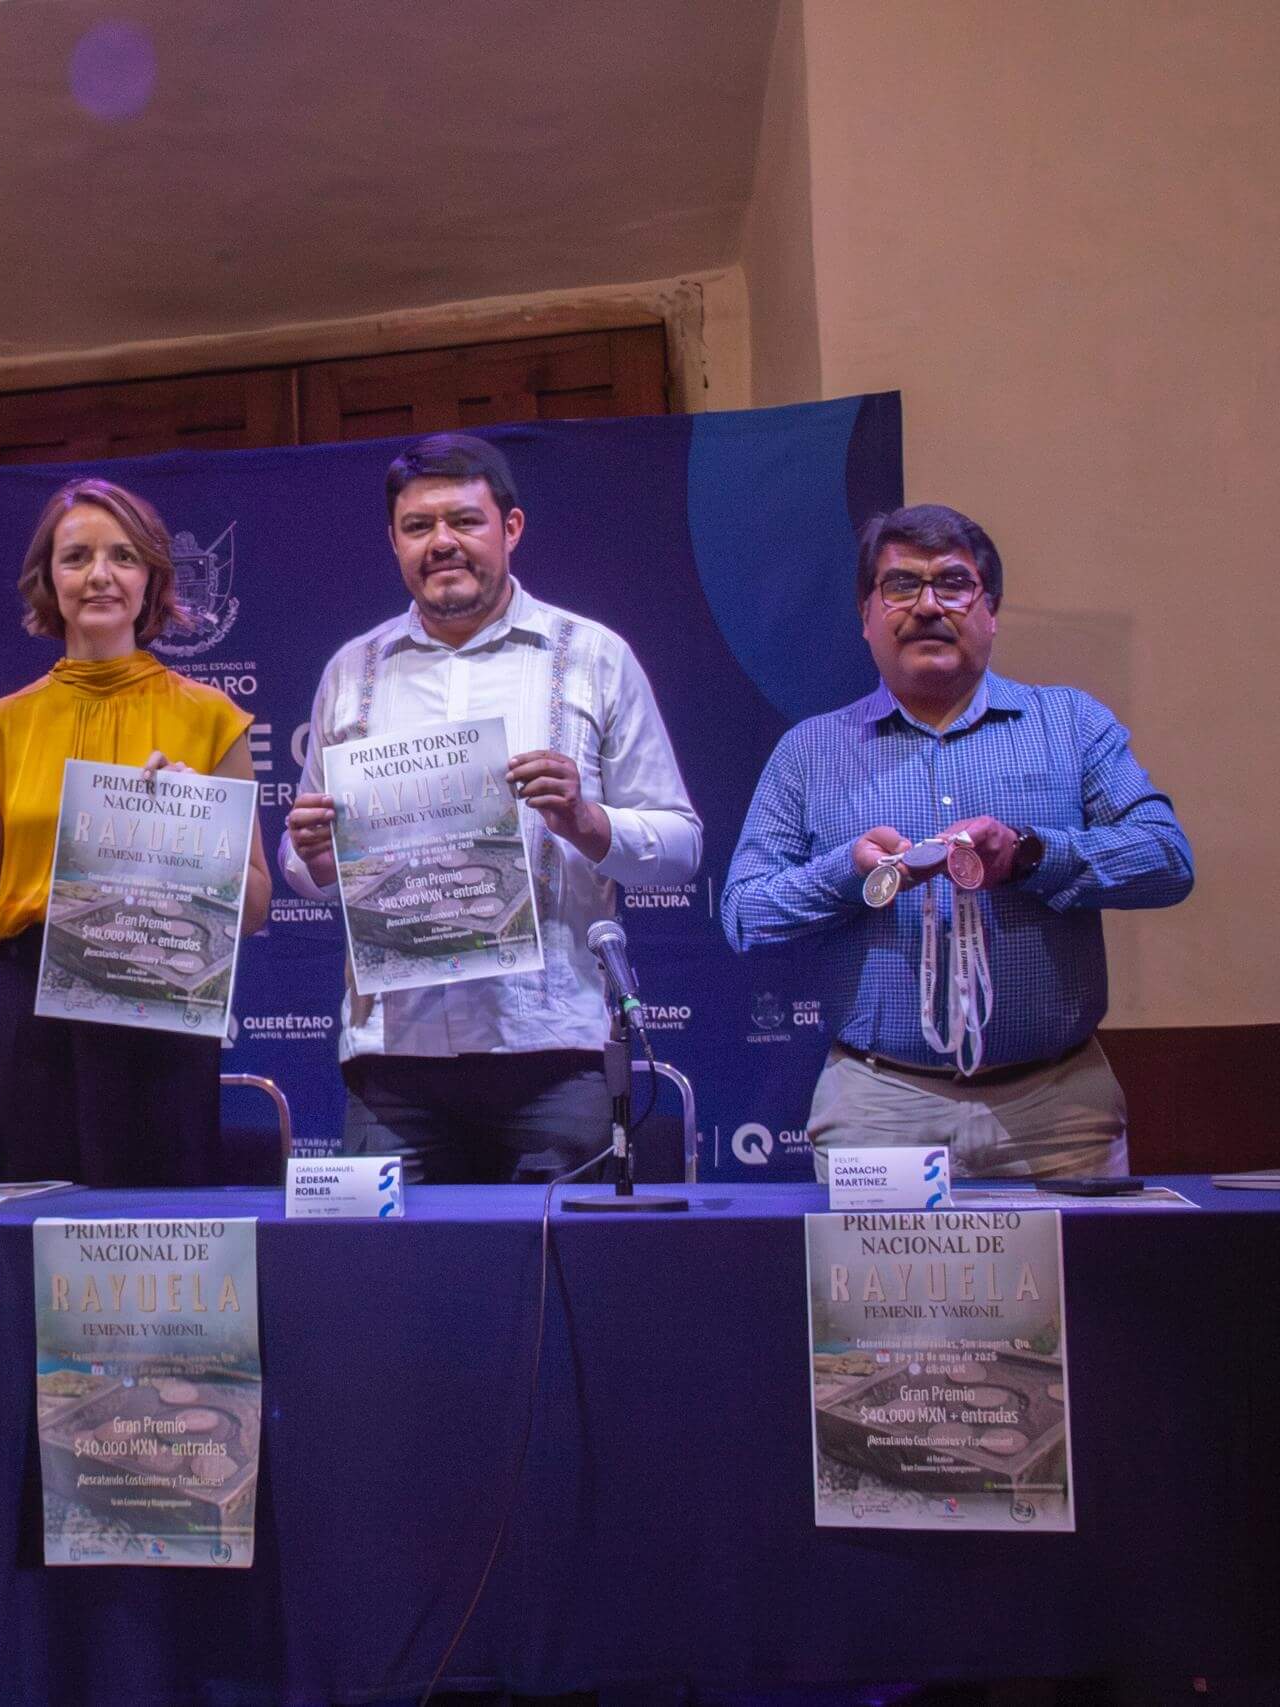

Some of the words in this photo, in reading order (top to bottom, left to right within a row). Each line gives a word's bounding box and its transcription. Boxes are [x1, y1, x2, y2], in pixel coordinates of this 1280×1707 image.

[349, 741, 408, 766] PRIMER
[412, 729, 480, 751] TORNEO
[363, 758, 444, 781] NACIONAL
[447, 749, 470, 766] DE
[92, 774, 156, 795] PRIMER
[160, 782, 227, 803] TORNEO
[342, 764, 501, 821] RAYUELA
[103, 794, 186, 817] NACIONAL
[190, 805, 212, 821] DE
[370, 813, 418, 830] FEMENIL
[419, 811, 427, 822] Y
[428, 804, 476, 820] VARONIL
[73, 811, 233, 861] RAYUELA
[97, 847, 145, 863] FEMENIL
[147, 853, 155, 864] Y
[156, 854, 204, 870] VARONIL
[405, 874, 428, 889] Gran
[429, 870, 463, 886] Premio
[421, 890, 443, 904] MXN
[452, 881, 497, 899] entradas
[624, 894, 690, 908] CULTURA
[115, 912, 138, 926] Gran
[139, 916, 172, 930] Premio
[271, 908, 333, 922] CULTURA
[125, 931, 149, 945] MXN
[158, 934, 201, 951] entradas
[243, 1013, 333, 1030] QUERÉTARO
[250, 1031, 283, 1040] JUNTOS
[325, 1165, 354, 1173] MANUEL
[834, 1165, 887, 1175] CAMACHO
[295, 1175, 340, 1184] LEDESMA
[834, 1177, 888, 1187] MARTÍNEZ
[295, 1186, 331, 1196] ROBLES
[64, 1222, 139, 1239] PRIMER
[143, 1221, 225, 1239] TORNEO
[843, 1213, 926, 1231] PRIMER
[934, 1212, 1021, 1230] TORNEO
[80, 1244, 178, 1262] NACIONAL
[183, 1244, 209, 1261] DE
[861, 1236, 971, 1254] NACIONAL
[976, 1236, 1005, 1253] DE
[830, 1262, 1040, 1303] RAYUELA
[51, 1272, 241, 1313] RAYUELA
[864, 1304, 927, 1319] FEMENIL
[931, 1305, 940, 1319] Y
[940, 1304, 1004, 1319] VARONIL
[82, 1323, 138, 1337] FEMENIL
[141, 1323, 149, 1336] Y
[150, 1323, 208, 1337] VARONIL
[899, 1385, 929, 1402] Gran
[931, 1385, 976, 1401] Premio
[860, 1406, 916, 1424] $40.000
[919, 1407, 947, 1424] MXN
[960, 1406, 1019, 1424] entradas
[113, 1416, 141, 1433] Gran
[144, 1416, 186, 1433] Premio
[74, 1439, 128, 1457] $40.000
[130, 1439, 158, 1456] MXN
[171, 1438, 228, 1456] entradas
